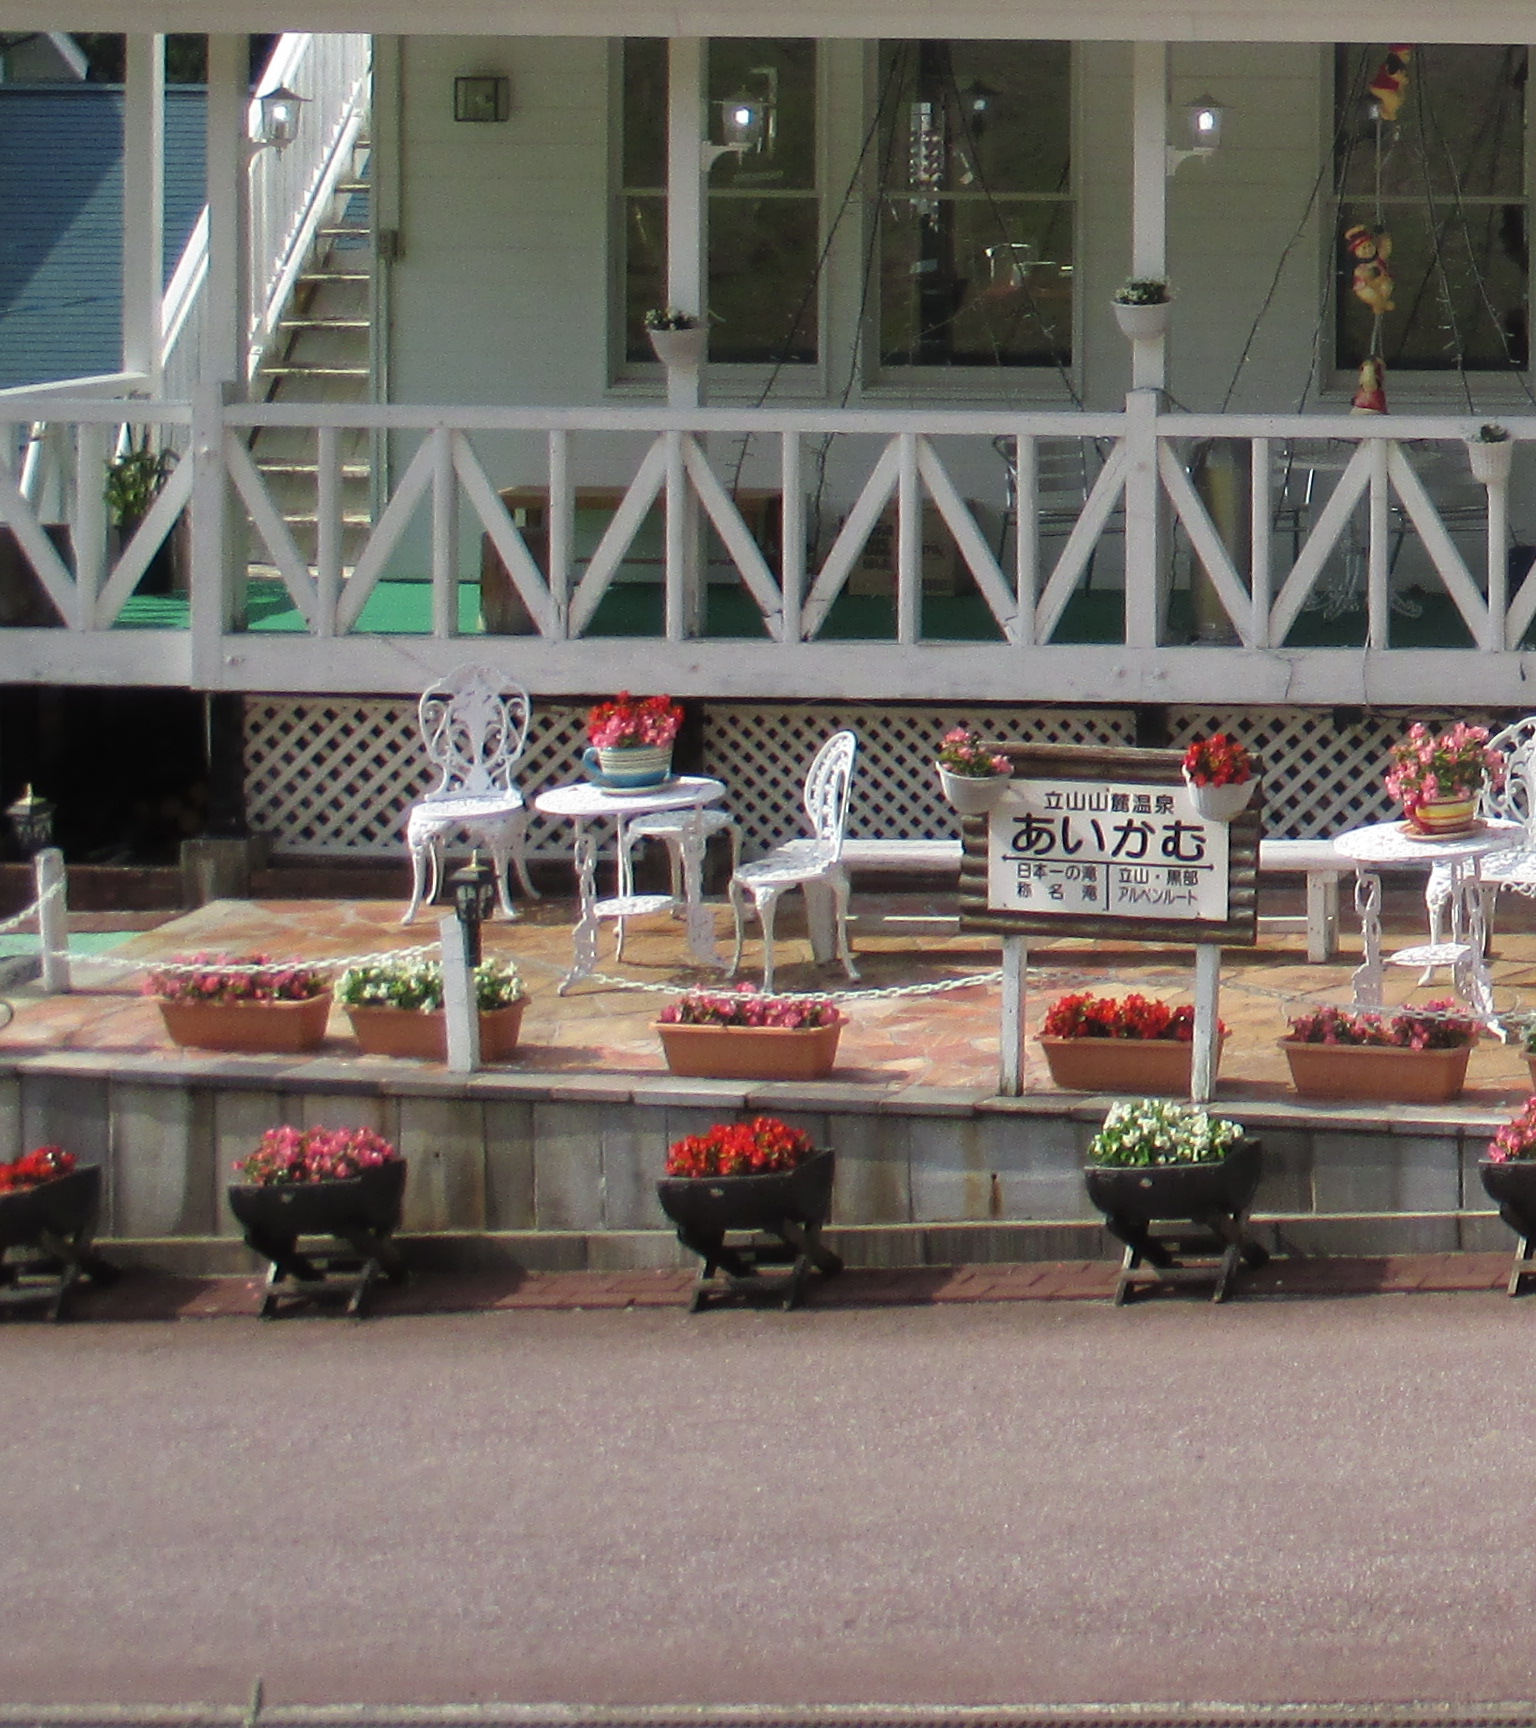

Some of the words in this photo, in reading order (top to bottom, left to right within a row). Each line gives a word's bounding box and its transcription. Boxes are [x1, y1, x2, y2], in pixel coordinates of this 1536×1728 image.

[1044, 790, 1175, 815] 立山山麓温泉
[1011, 812, 1207, 862] あいかむ
[1017, 862, 1098, 883] 日本一の滝
